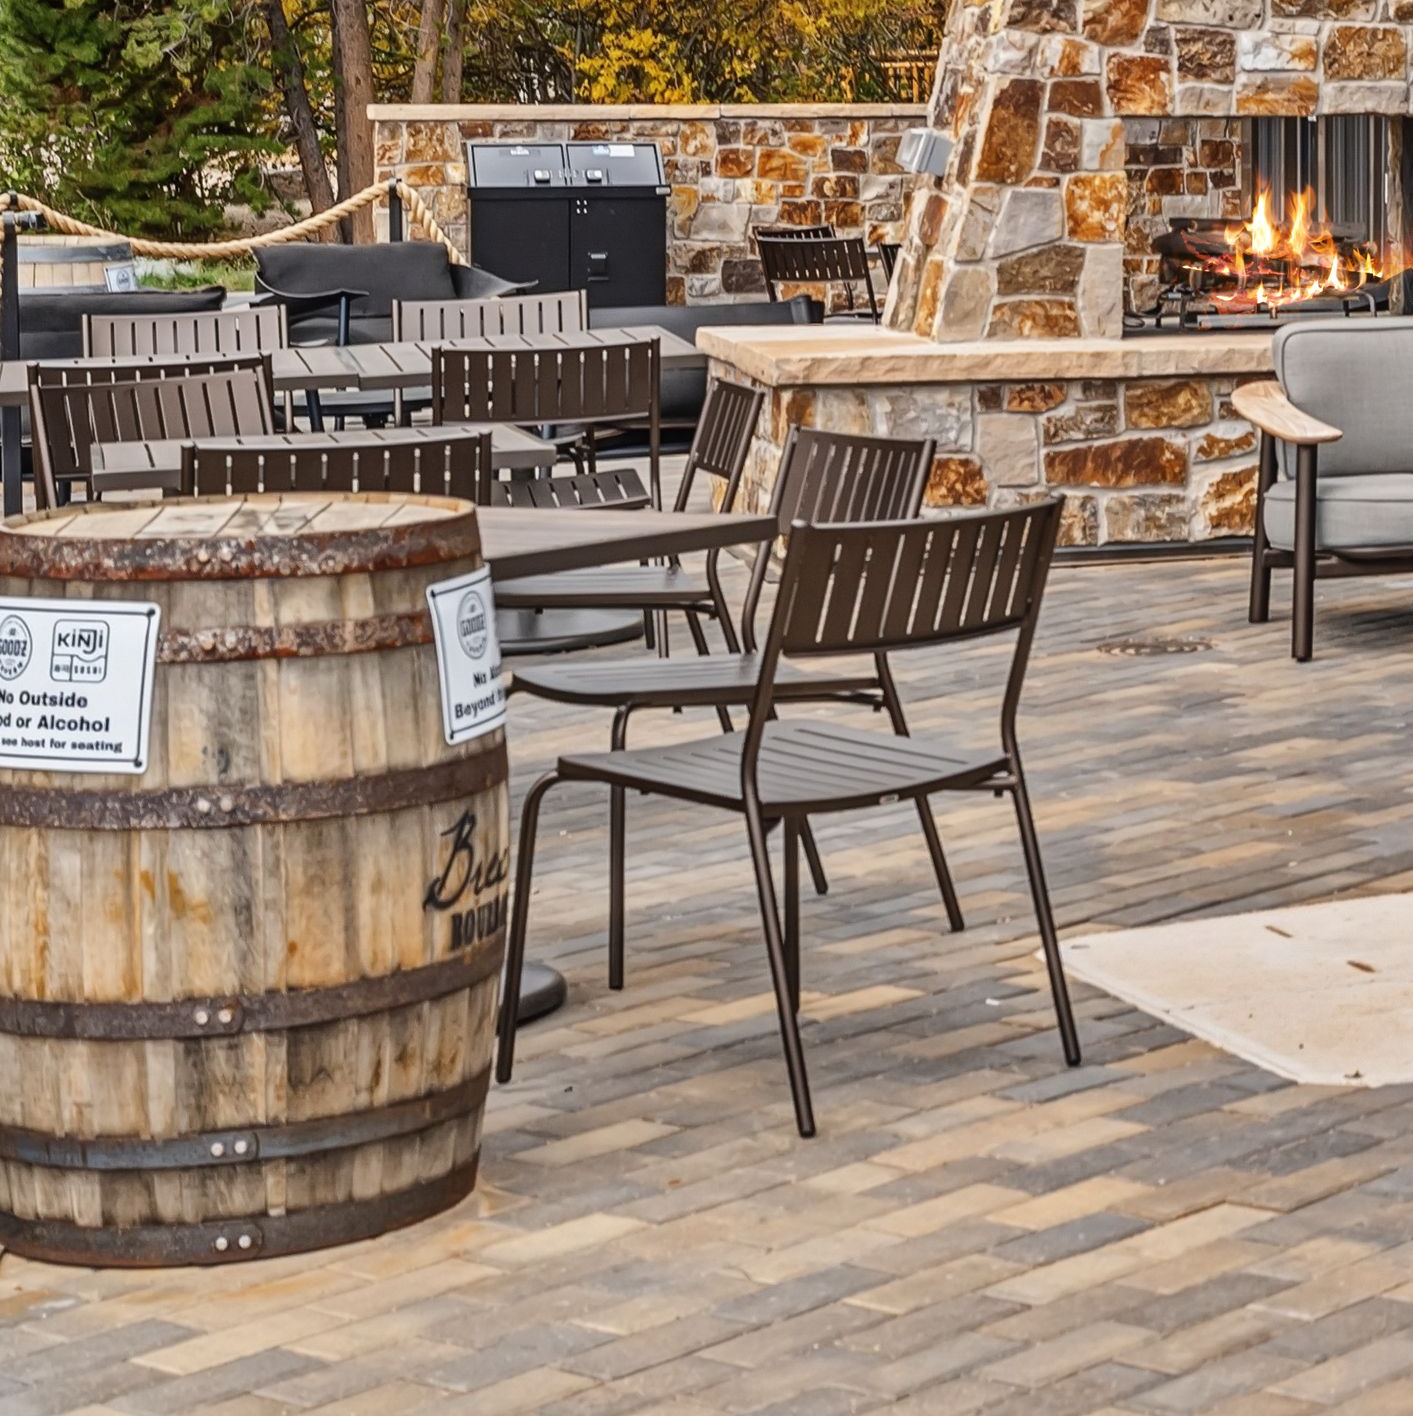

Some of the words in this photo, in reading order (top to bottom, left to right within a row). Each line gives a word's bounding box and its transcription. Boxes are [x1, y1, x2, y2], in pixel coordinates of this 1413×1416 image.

[19, 690, 88, 708] Outside
[454, 692, 496, 719] Beyond
[16, 716, 32, 728] or
[37, 714, 110, 732] Alcohol
[21, 736, 45, 748] host
[50, 737, 67, 749] for
[71, 740, 123, 754] seating
